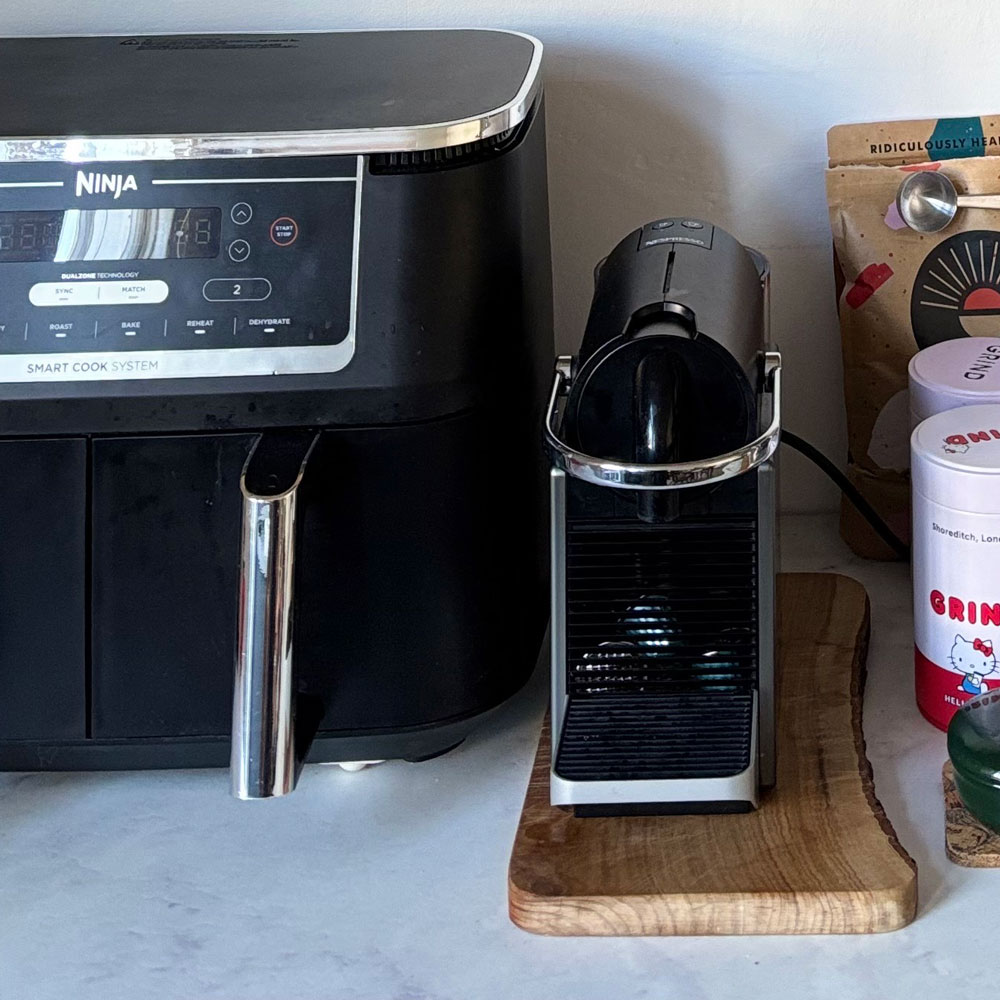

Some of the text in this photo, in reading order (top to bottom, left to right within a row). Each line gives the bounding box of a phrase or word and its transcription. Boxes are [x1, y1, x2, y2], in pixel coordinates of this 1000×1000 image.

[870, 137, 967, 155] RIDICULOUSLY
[75, 170, 139, 200] NINJA
[61, 271, 140, 280] DUALZONE TECHNOLOGY
[121, 285, 146, 293] MATCH
[232, 284, 241, 295] 2
[121, 321, 141, 329] BAKE
[186, 319, 214, 327] REHEAT
[248, 318, 291, 326] DEHYDRATE
[26, 360, 159, 374] SMART COOK SYSTEM
[932, 522, 979, 543] Shoreditch,
